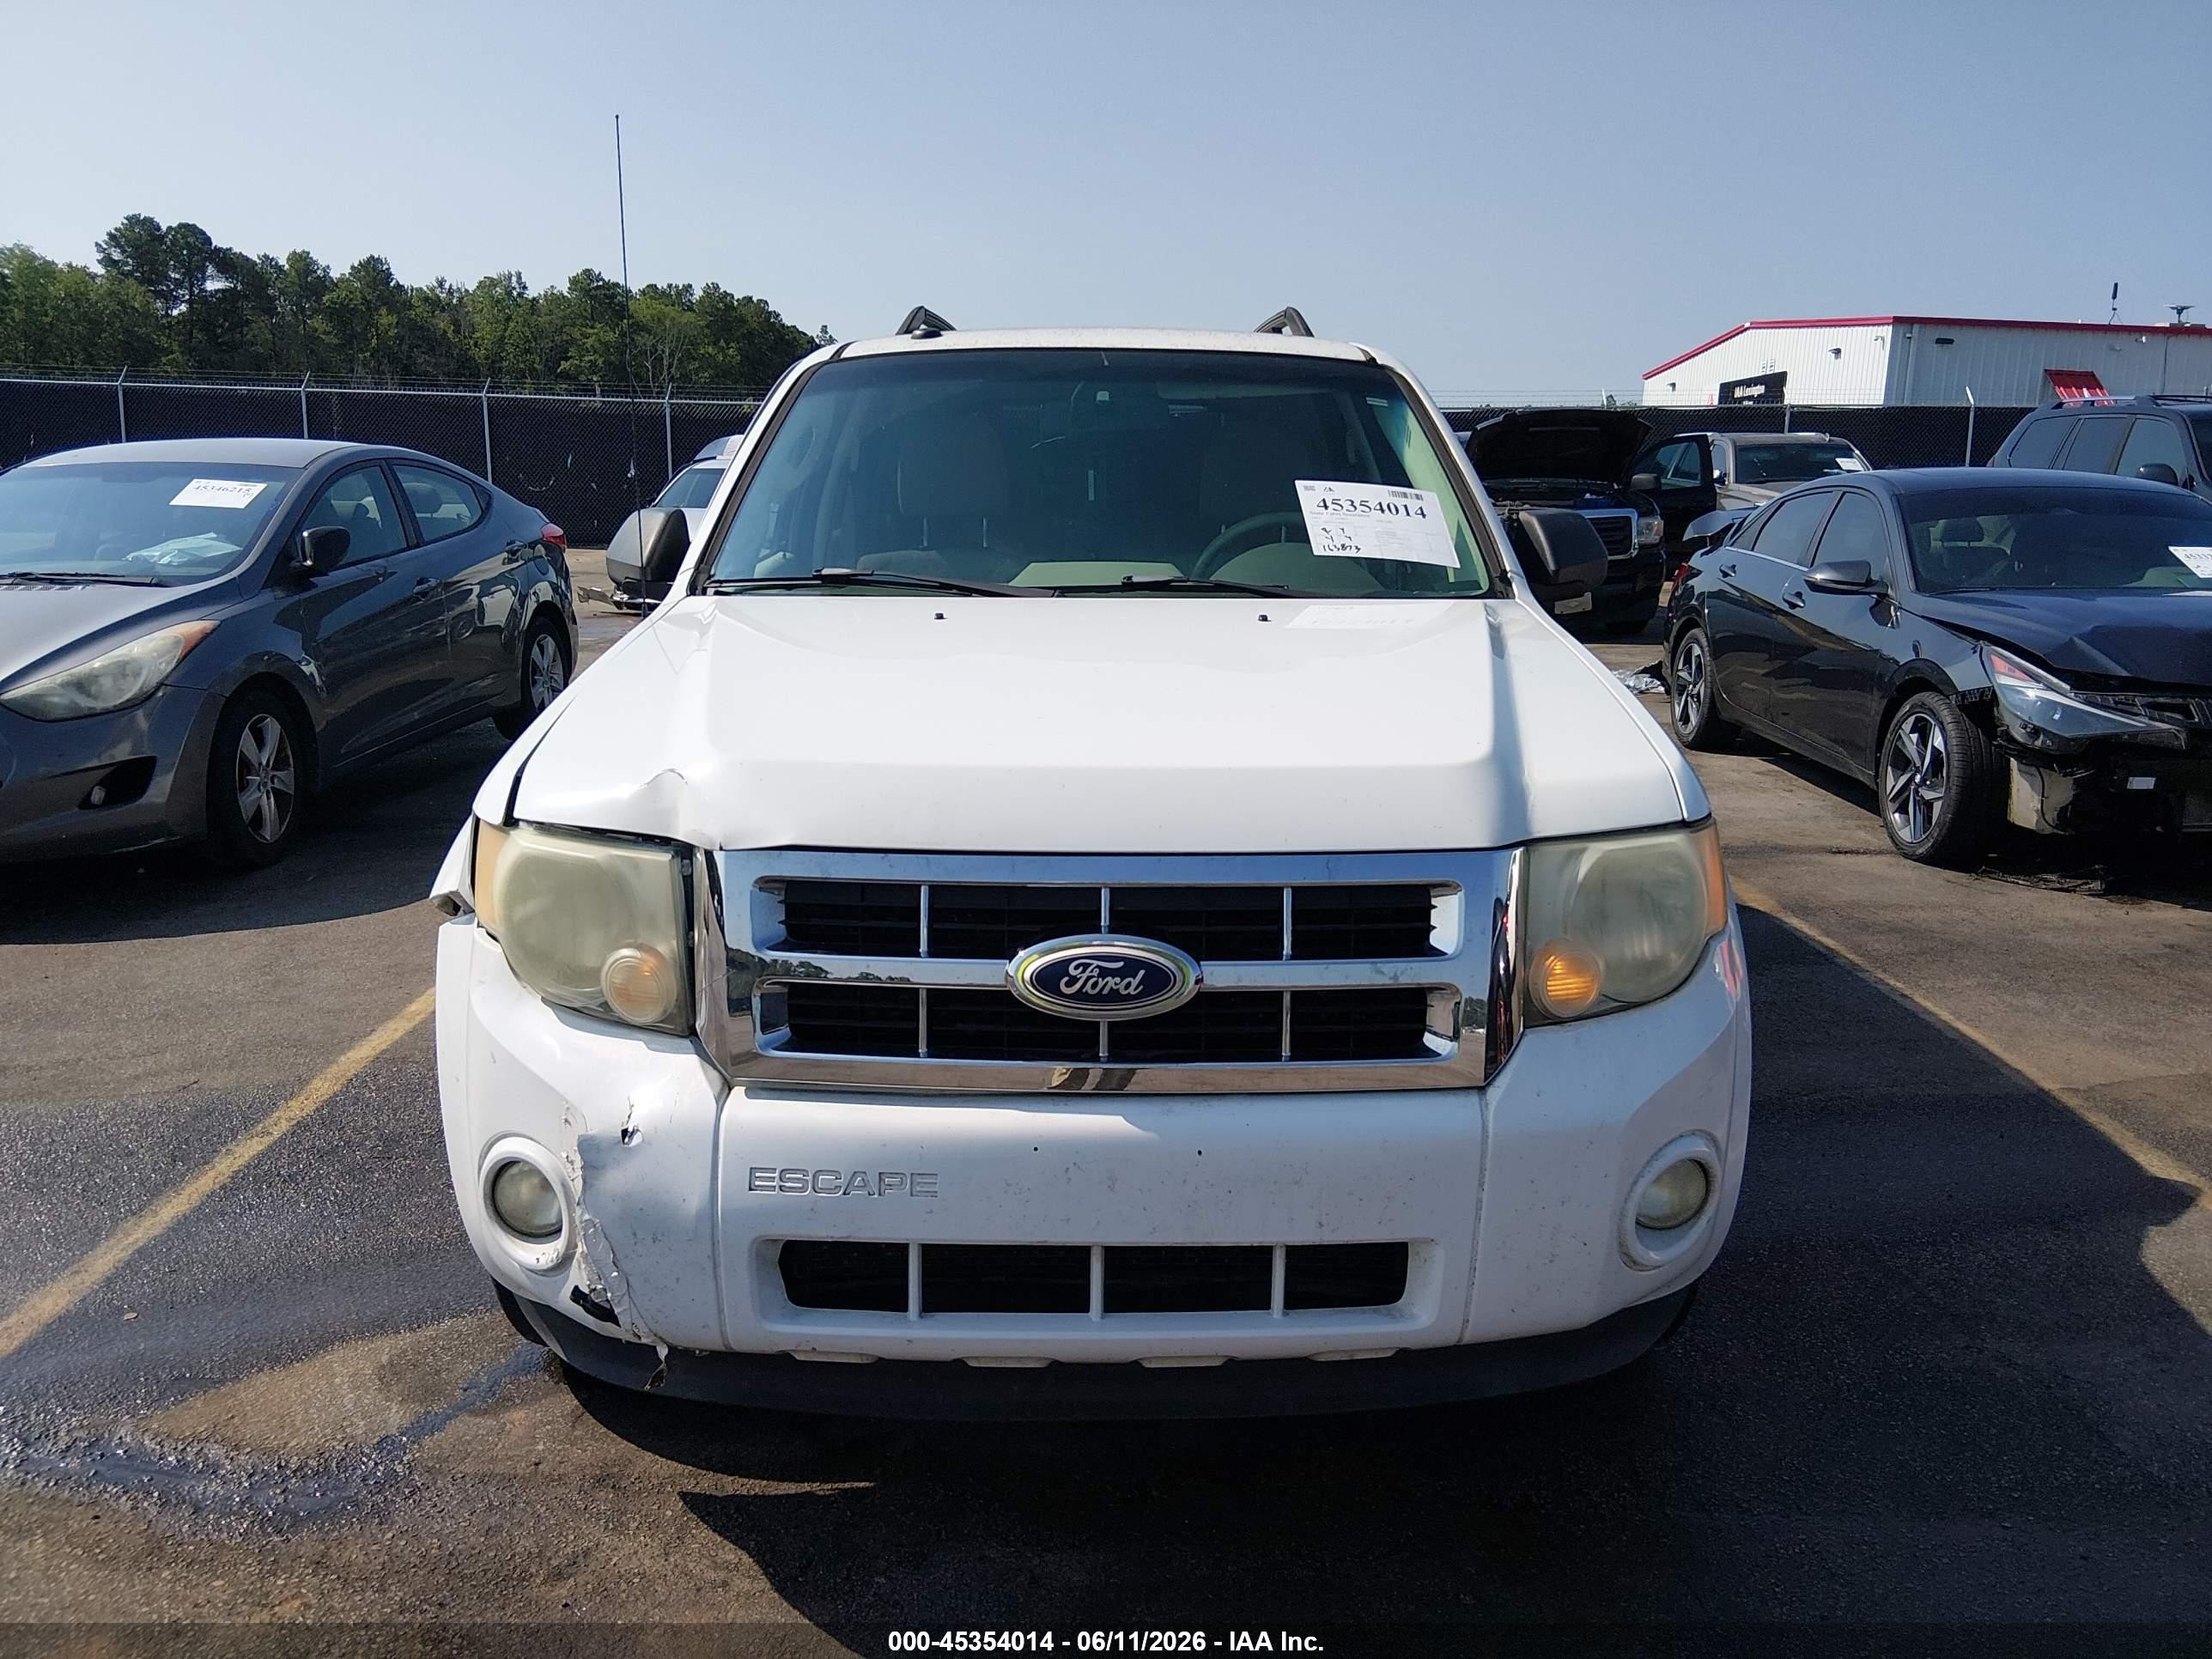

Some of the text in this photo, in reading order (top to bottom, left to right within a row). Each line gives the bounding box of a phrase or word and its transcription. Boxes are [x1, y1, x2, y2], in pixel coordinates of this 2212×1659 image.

[1316, 497, 1427, 520] 45354014
[1059, 958, 1146, 995] Ford
[748, 1166, 939, 1198] ESCAPE
